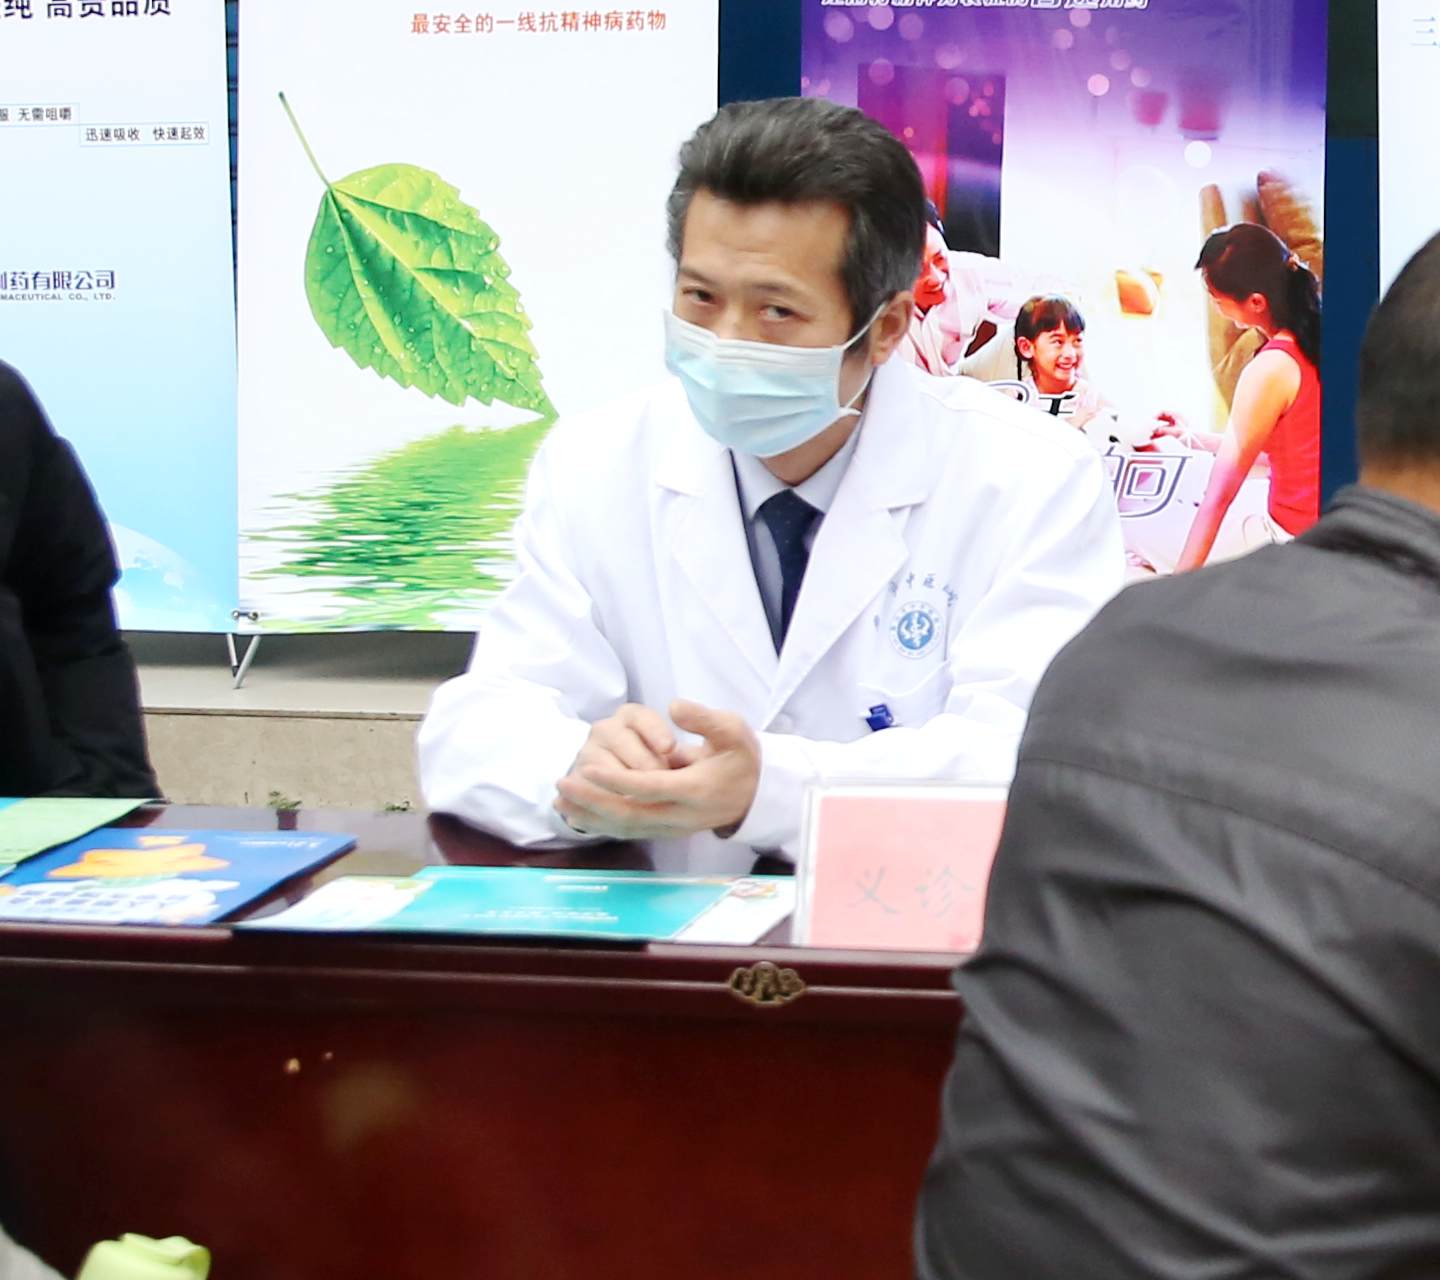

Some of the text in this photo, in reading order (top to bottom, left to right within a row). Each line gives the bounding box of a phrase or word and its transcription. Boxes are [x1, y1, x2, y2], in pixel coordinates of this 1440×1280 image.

[410, 9, 667, 35] 最安全的一线抗精神病药物
[17, 107, 72, 121] 无需咀嚼
[85, 125, 205, 142] 迅速吸收 快速起效
